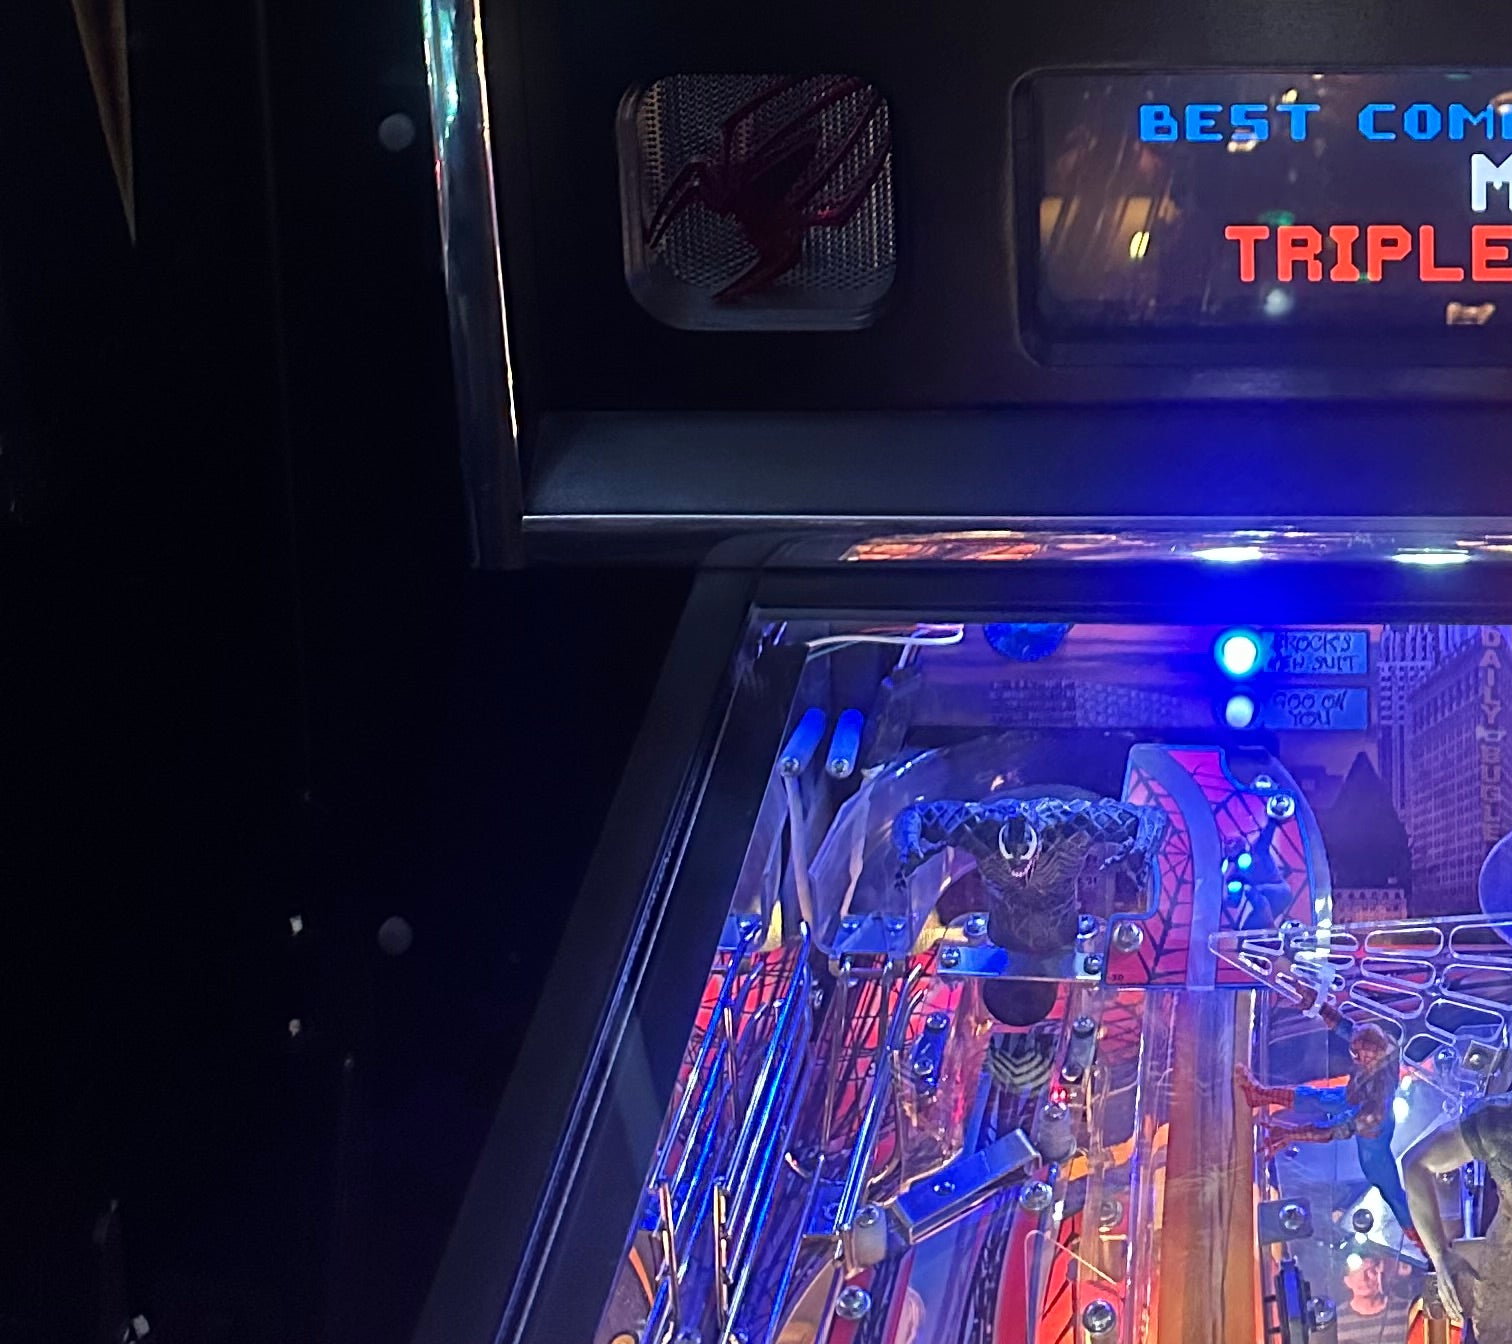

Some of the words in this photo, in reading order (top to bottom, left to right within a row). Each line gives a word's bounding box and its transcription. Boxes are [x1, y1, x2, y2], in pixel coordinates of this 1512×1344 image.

[1139, 104, 1320, 142] BEST
[1480, 625, 1502, 725] DAILY
[1288, 710, 1331, 727] YOU
[1481, 744, 1501, 842] BUGLE
